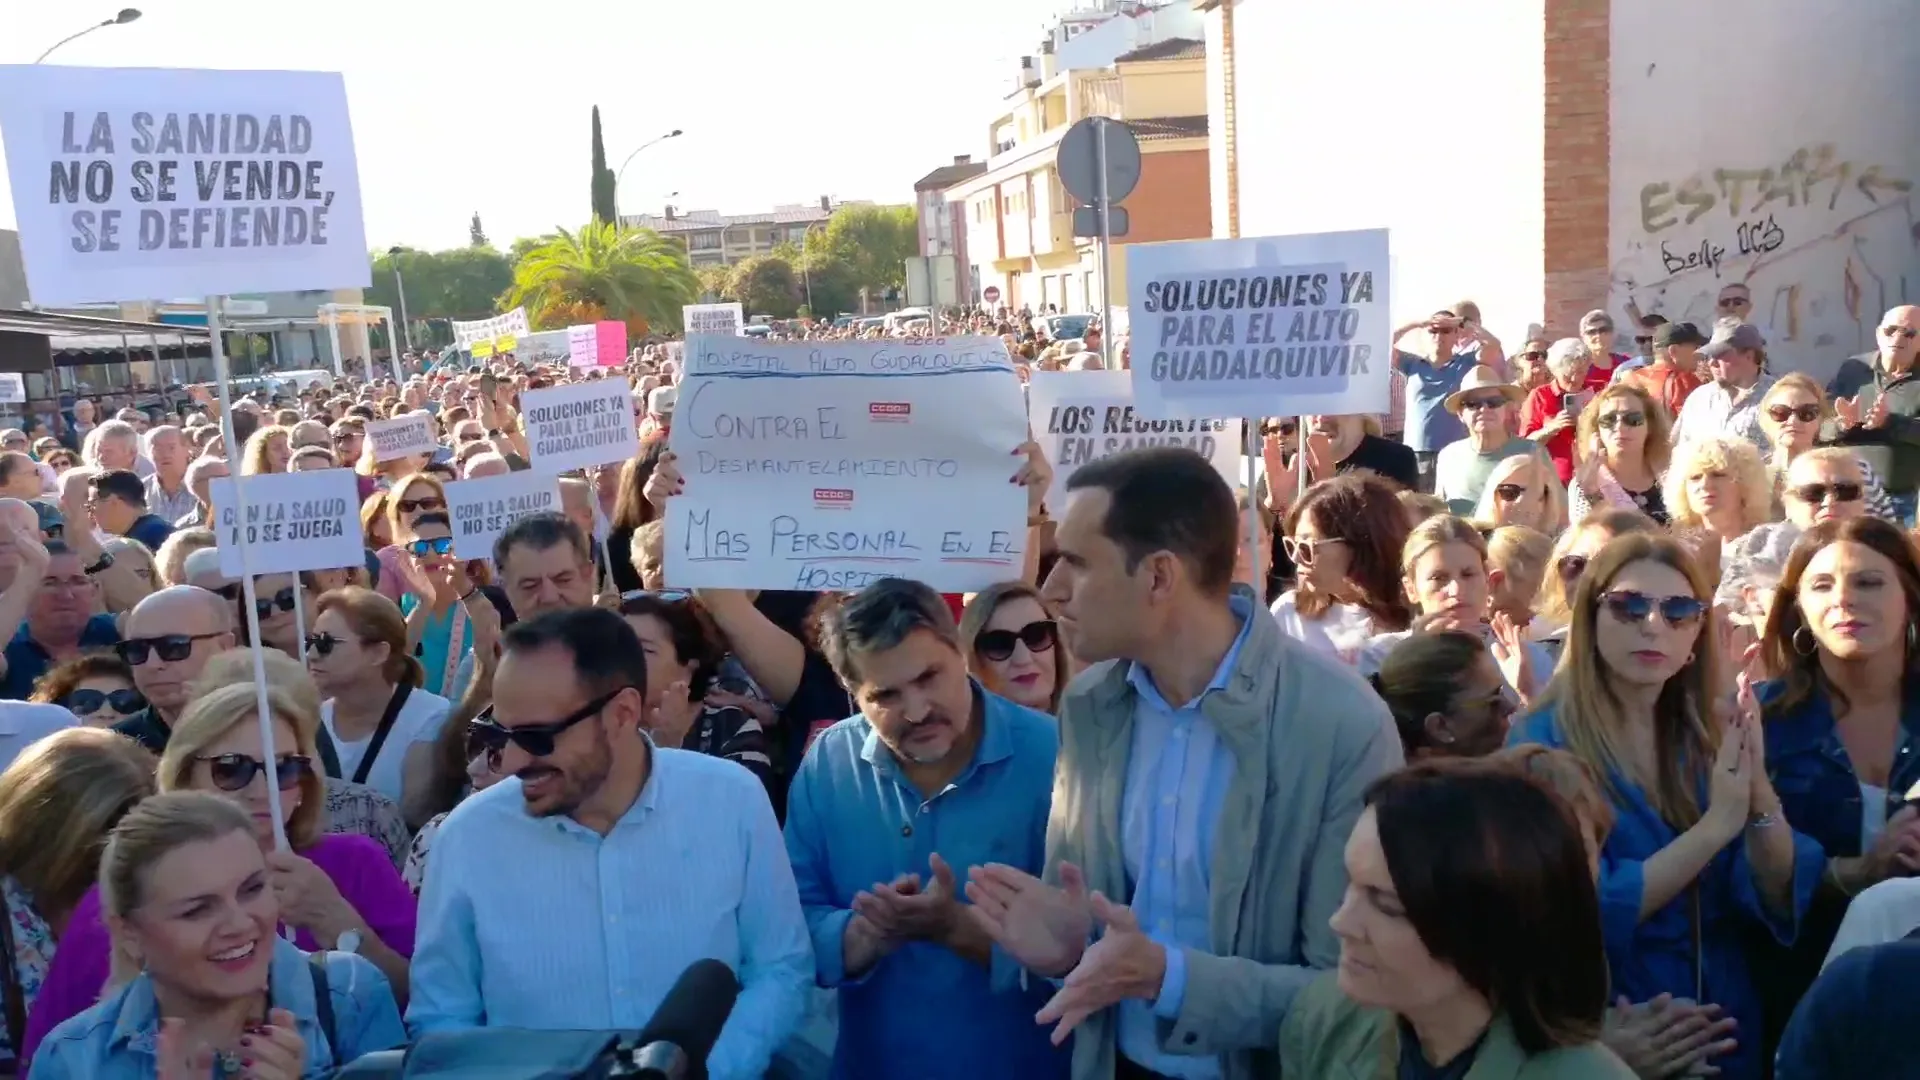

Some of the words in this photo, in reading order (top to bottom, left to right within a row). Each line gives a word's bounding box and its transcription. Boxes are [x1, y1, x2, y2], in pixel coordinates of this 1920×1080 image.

[62, 112, 115, 153] LA
[131, 112, 312, 154] SANIDAD
[50, 161, 113, 203] NO
[131, 161, 178, 202] SE
[194, 161, 335, 206] VENDE,
[71, 210, 121, 253] SE
[139, 206, 328, 250] DEFIENDE
[1144, 273, 1328, 312] SOLUCIONES
[1340, 271, 1373, 304] YA
[1160, 314, 1235, 347] PARA
[1246, 312, 1276, 344] EL
[1285, 308, 1360, 342] ALTO
[697, 340, 789, 371] HOSPITAL
[809, 349, 857, 371] ALTO
[1151, 344, 1372, 382] GUADALQUIVIR
[529, 398, 606, 424] SOLUCIONES
[610, 396, 624, 410] YA
[688, 381, 808, 439] CONTRA
[817, 406, 847, 439] EL
[1048, 405, 1095, 434] LOS
[539, 421, 572, 439] PARA
[576, 418, 588, 433] EL
[593, 412, 620, 430] ALTO
[536, 427, 628, 456] GUADALQUIVIR
[1059, 437, 1095, 465] EN
[698, 450, 958, 478] DESMANTELAMIENTO
[266, 503, 285, 522] LA
[292, 498, 346, 519] SALUD
[456, 502, 483, 520] CON
[489, 500, 504, 515] LA
[509, 491, 551, 512] SALUD
[262, 523, 281, 542] SE
[288, 518, 343, 540] JUEGA
[463, 519, 482, 535] NO
[487, 516, 502, 531] SE
[685, 508, 750, 558] MAS
[771, 515, 922, 557] PERSONAL
[941, 531, 972, 552] EN
[989, 531, 1021, 553] EL
